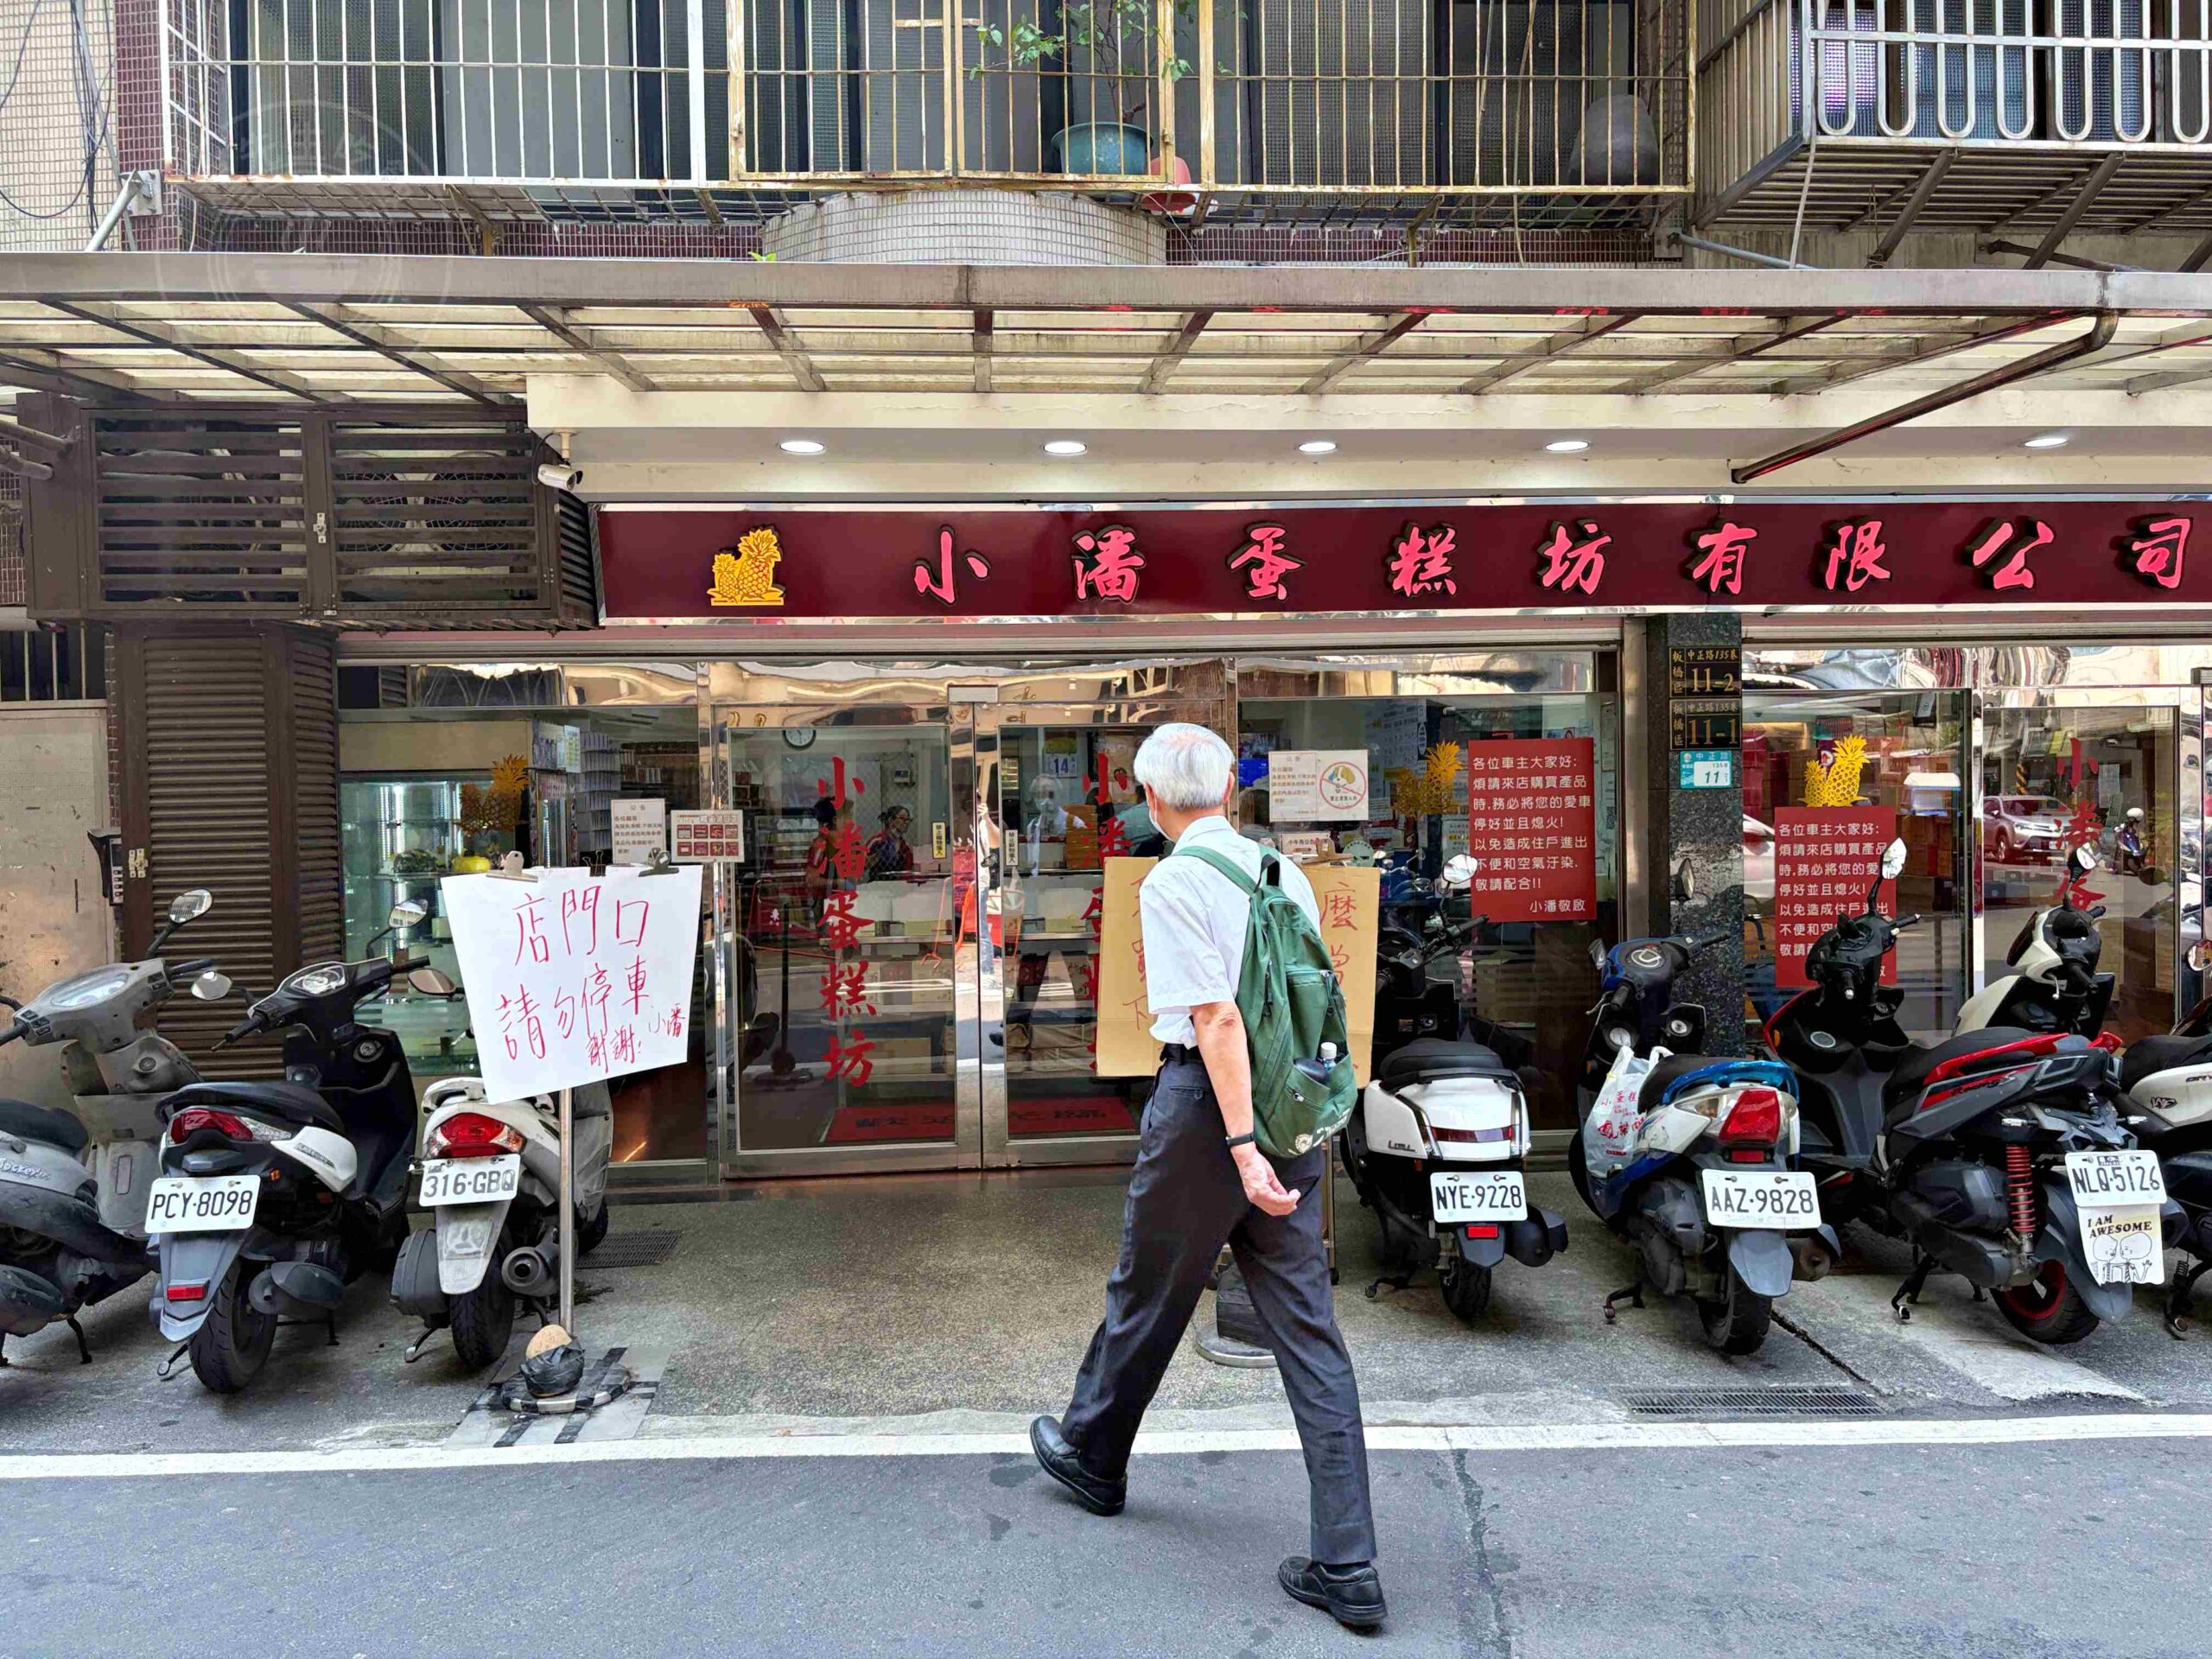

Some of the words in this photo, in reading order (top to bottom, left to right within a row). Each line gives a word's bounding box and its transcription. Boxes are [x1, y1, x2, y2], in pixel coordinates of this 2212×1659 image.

[914, 516, 2194, 605] 小潘蛋糕坊有限公司
[1687, 649, 1739, 661] 中正路135巷
[1691, 667, 1735, 692] 11-2
[1688, 702, 1738, 713] 中正路135巷
[1688, 718, 1738, 745] 11-1
[1053, 758, 1069, 773] 14
[1472, 755, 1578, 771] 各位車主大家好:
[1472, 775, 1586, 791] 煩請來店購買產品
[1705, 771, 1719, 784] 11
[1474, 817, 1564, 831] 停好並且熄火!
[1778, 823, 1879, 836] 各位車主大家好:
[1474, 836, 1587, 851] 以免造成住戶進出
[1779, 861, 1879, 877] 時,務必將您的愛
[1475, 877, 1541, 892] 敬請配合!!
[1779, 883, 1866, 896] 停好並且熄火!
[512, 885, 650, 966] 店門口
[817, 756, 877, 1087] 小潘蛋糕坊
[1780, 924, 1839, 937] 不便和空
[1780, 943, 1811, 957] 敬請
[495, 955, 650, 1060] 請勿停車
[585, 1024, 642, 1073] 謝謝!
[2088, 1218, 2093, 1228] I
[2094, 1214, 2113, 1226] AM
[2089, 1221, 2152, 1239] AWESOME
